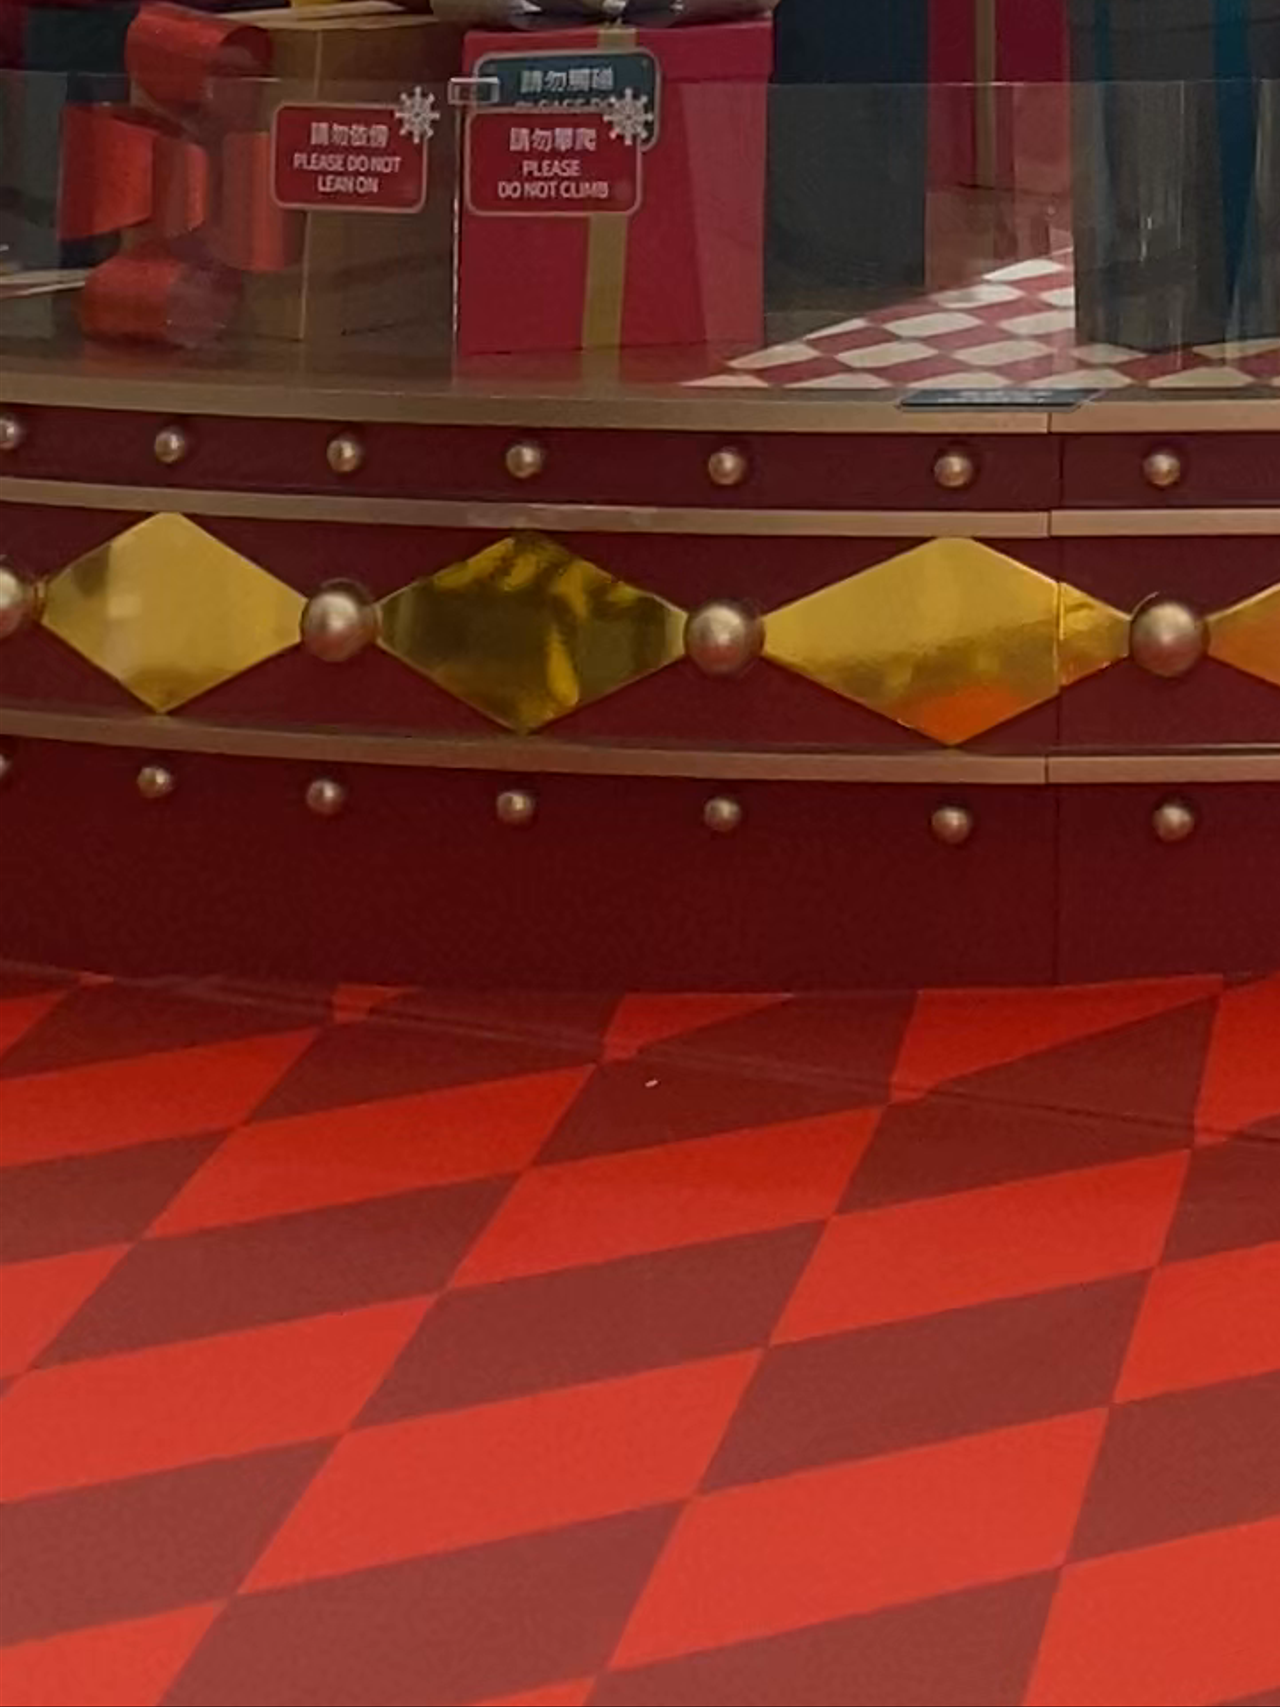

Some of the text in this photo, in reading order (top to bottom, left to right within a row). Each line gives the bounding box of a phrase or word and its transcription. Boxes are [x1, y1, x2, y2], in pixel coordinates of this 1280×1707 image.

[293, 152, 401, 173] PLEASE DO NOT
[522, 159, 581, 178] PLEASE
[317, 175, 378, 194] LEAN ON
[497, 180, 609, 199] DO NOT CLIMB
